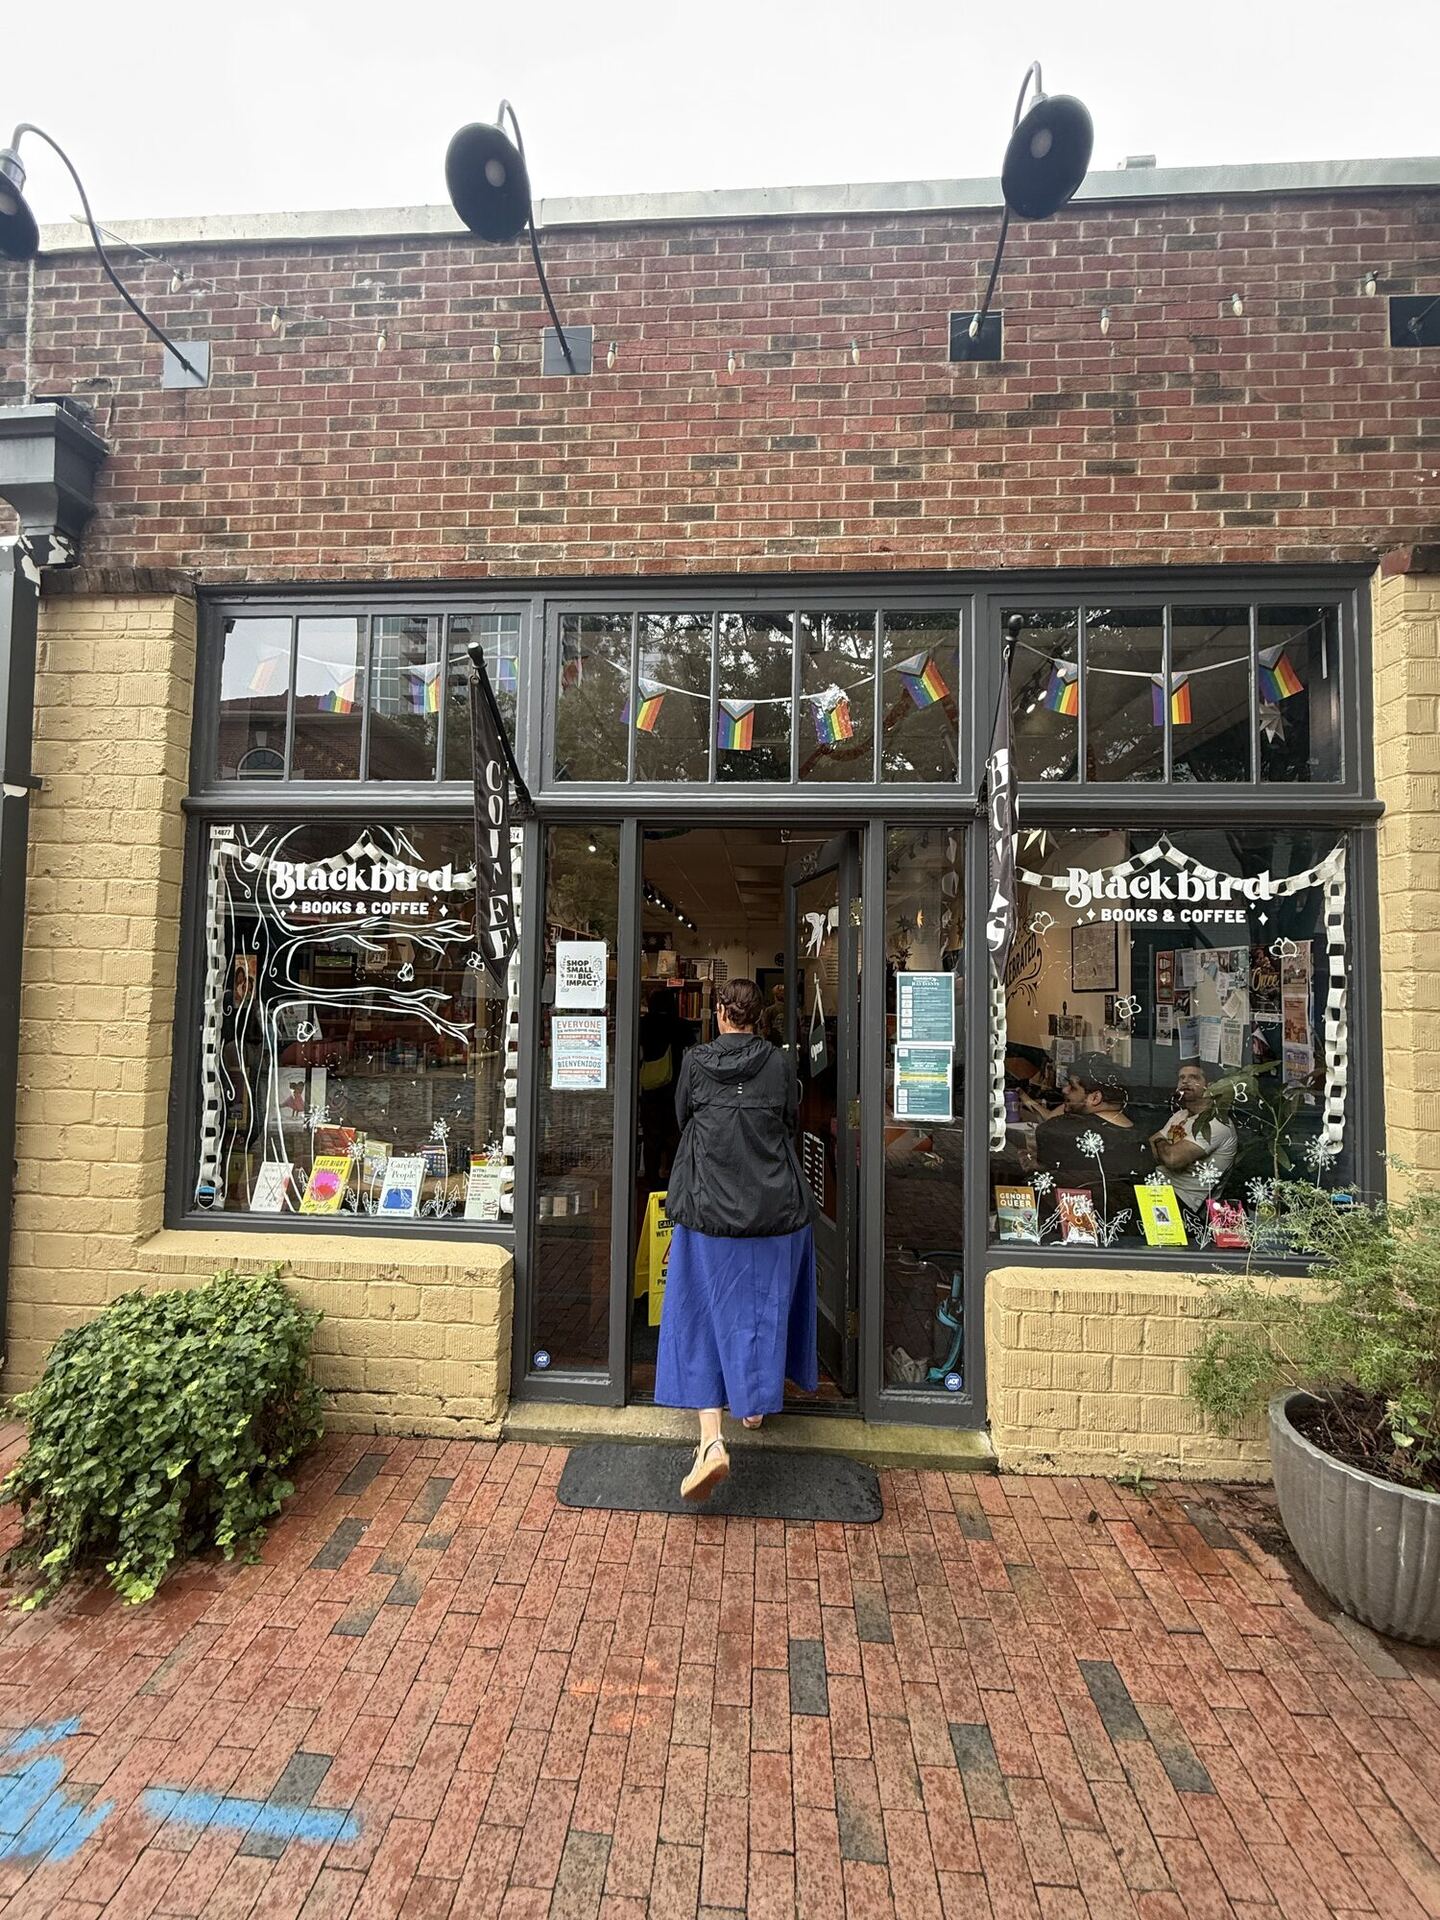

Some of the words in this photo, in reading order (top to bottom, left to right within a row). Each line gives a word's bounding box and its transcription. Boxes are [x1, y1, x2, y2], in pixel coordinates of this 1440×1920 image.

[272, 861, 455, 899] Blackbird
[1065, 867, 1273, 908] Blackbird
[301, 901, 352, 914] BOOKS
[355, 902, 367, 914] &
[371, 902, 429, 915] COFFEE
[1101, 908, 1157, 922] BOOKS
[1162, 909, 1175, 922] &
[1180, 909, 1246, 923] COFFEE
[557, 1020, 601, 1029] EVERYONE
[557, 1060, 602, 1068] BIENVENIDOS
[1000, 1192, 1031, 1200] GENDER
[1000, 1200, 1032, 1208] QUEER
[659, 1220, 675, 1228] CAUT
